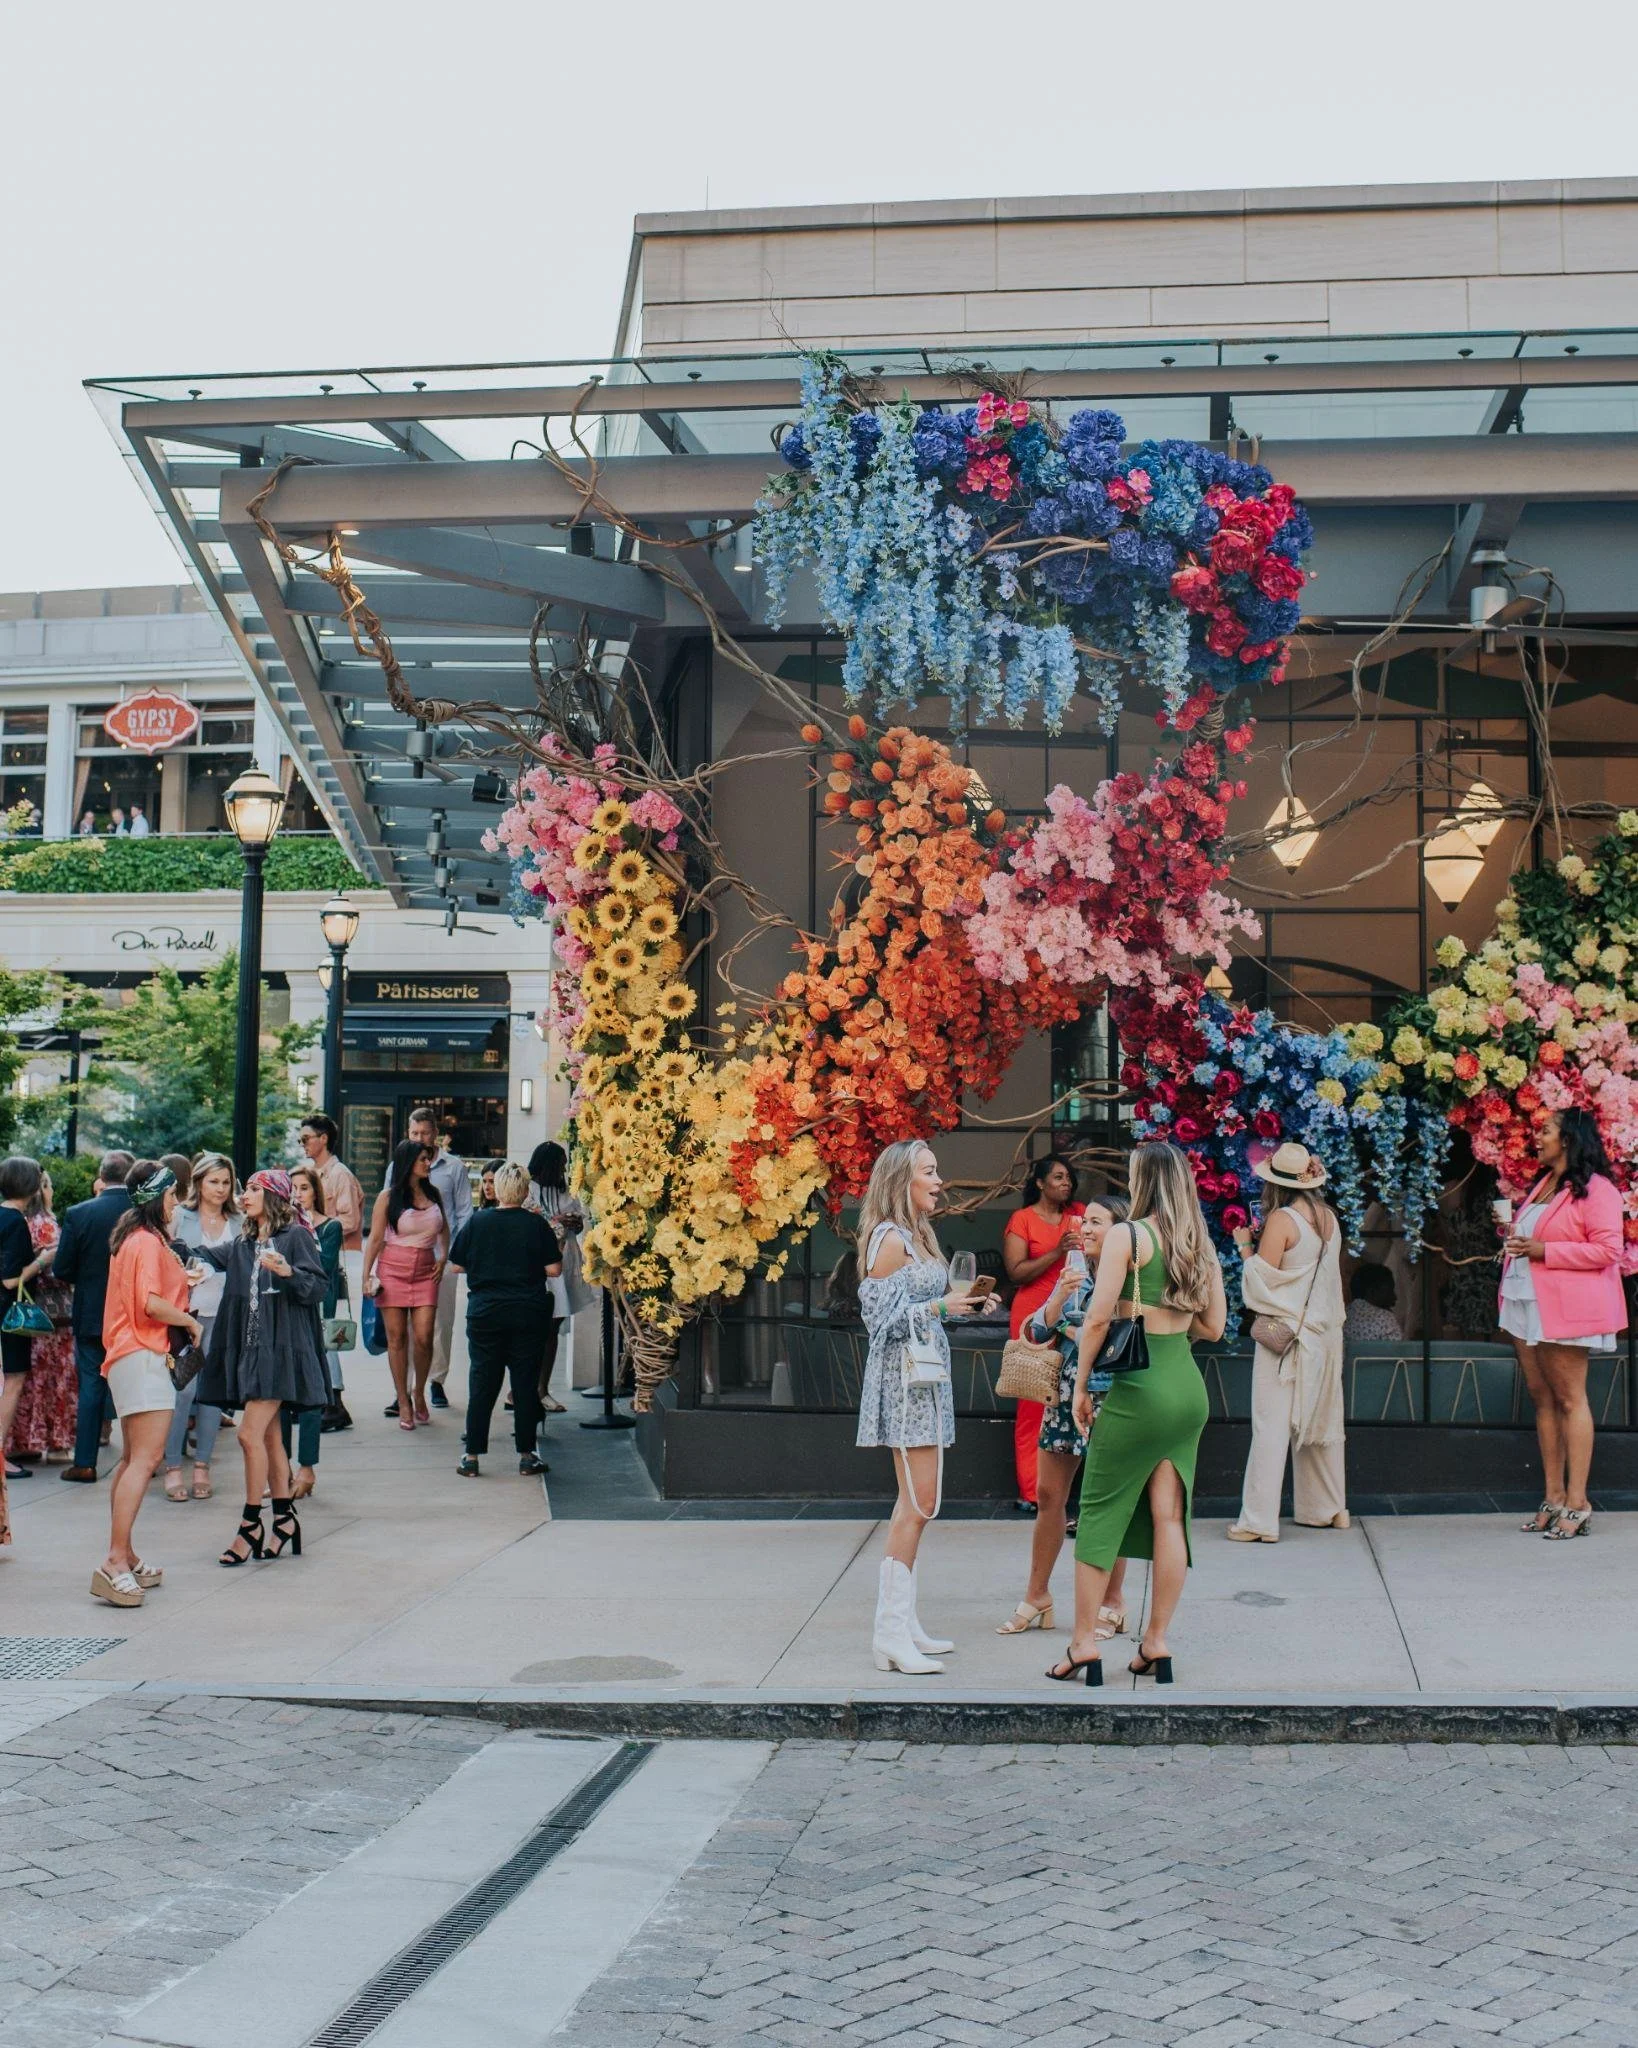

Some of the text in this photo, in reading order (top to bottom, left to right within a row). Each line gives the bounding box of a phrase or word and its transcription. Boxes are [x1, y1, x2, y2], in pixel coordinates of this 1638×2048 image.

[128, 708, 178, 728] GYPSY
[130, 728, 172, 737] KITCHEN
[377, 982, 480, 999] Pâtisserie
[378, 1036, 428, 1047] SAINT GERMAIN
